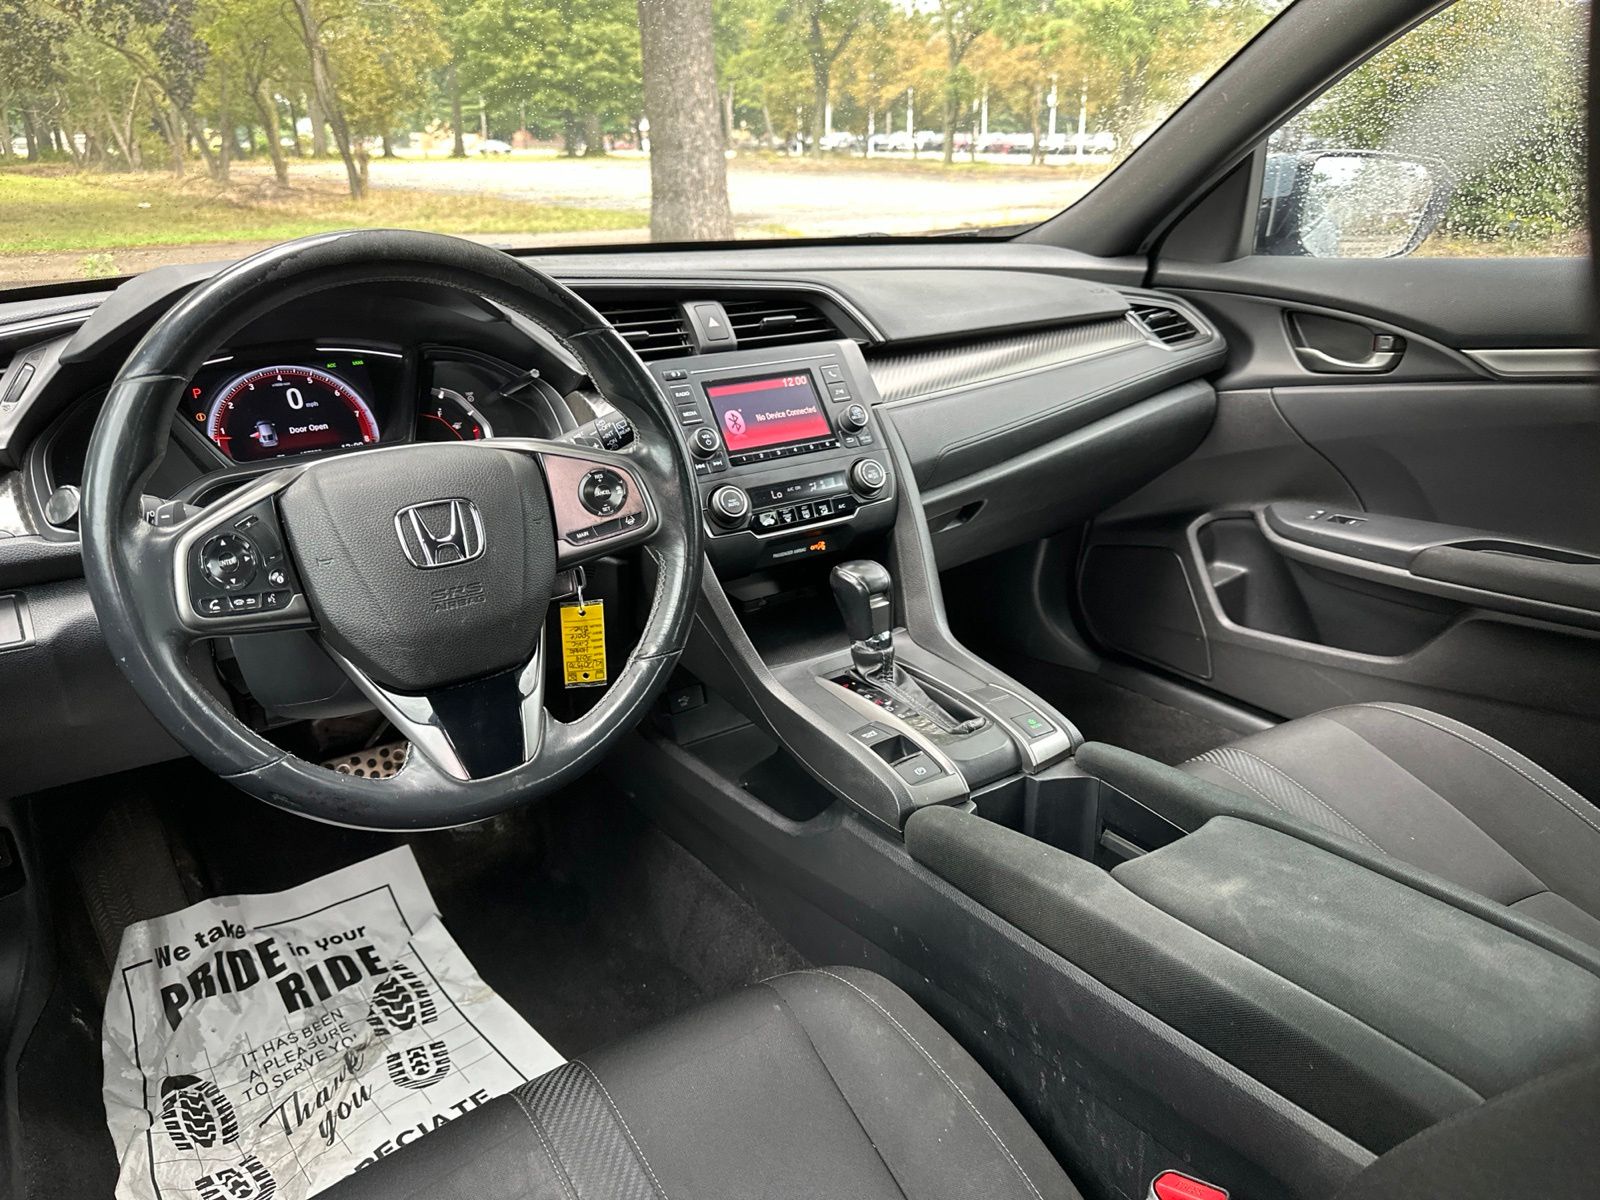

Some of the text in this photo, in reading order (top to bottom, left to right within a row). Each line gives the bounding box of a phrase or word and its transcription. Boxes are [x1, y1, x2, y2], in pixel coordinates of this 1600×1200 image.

[276, 374, 283, 382] 4
[307, 376, 314, 385] 5
[782, 375, 808, 388] 12:00
[192, 388, 202, 399] P
[248, 383, 255, 391] 3
[334, 389, 341, 397] 6
[286, 387, 320, 410] 0 mph
[675, 390, 690, 398] RADIO
[228, 402, 235, 410] 2
[354, 410, 360, 418] 7
[682, 410, 698, 418] MEDIA
[755, 405, 817, 422] No Device Connected
[289, 422, 329, 435] Door Open
[770, 490, 783, 499] Lo
[576, 531, 590, 539] MAIN
[431, 582, 484, 602] SRS
[433, 595, 487, 613] AIRBAG
[155, 920, 247, 969] We take
[160, 926, 366, 1032] PRIDE in your
[275, 945, 389, 1014] RIDE
[241, 1008, 344, 1067] IT HAS BEEN
[249, 1022, 351, 1083] A PLEASURE
[242, 1082, 269, 1102] TO
[274, 1049, 327, 1089] SERVE
[318, 1083, 372, 1146] you
